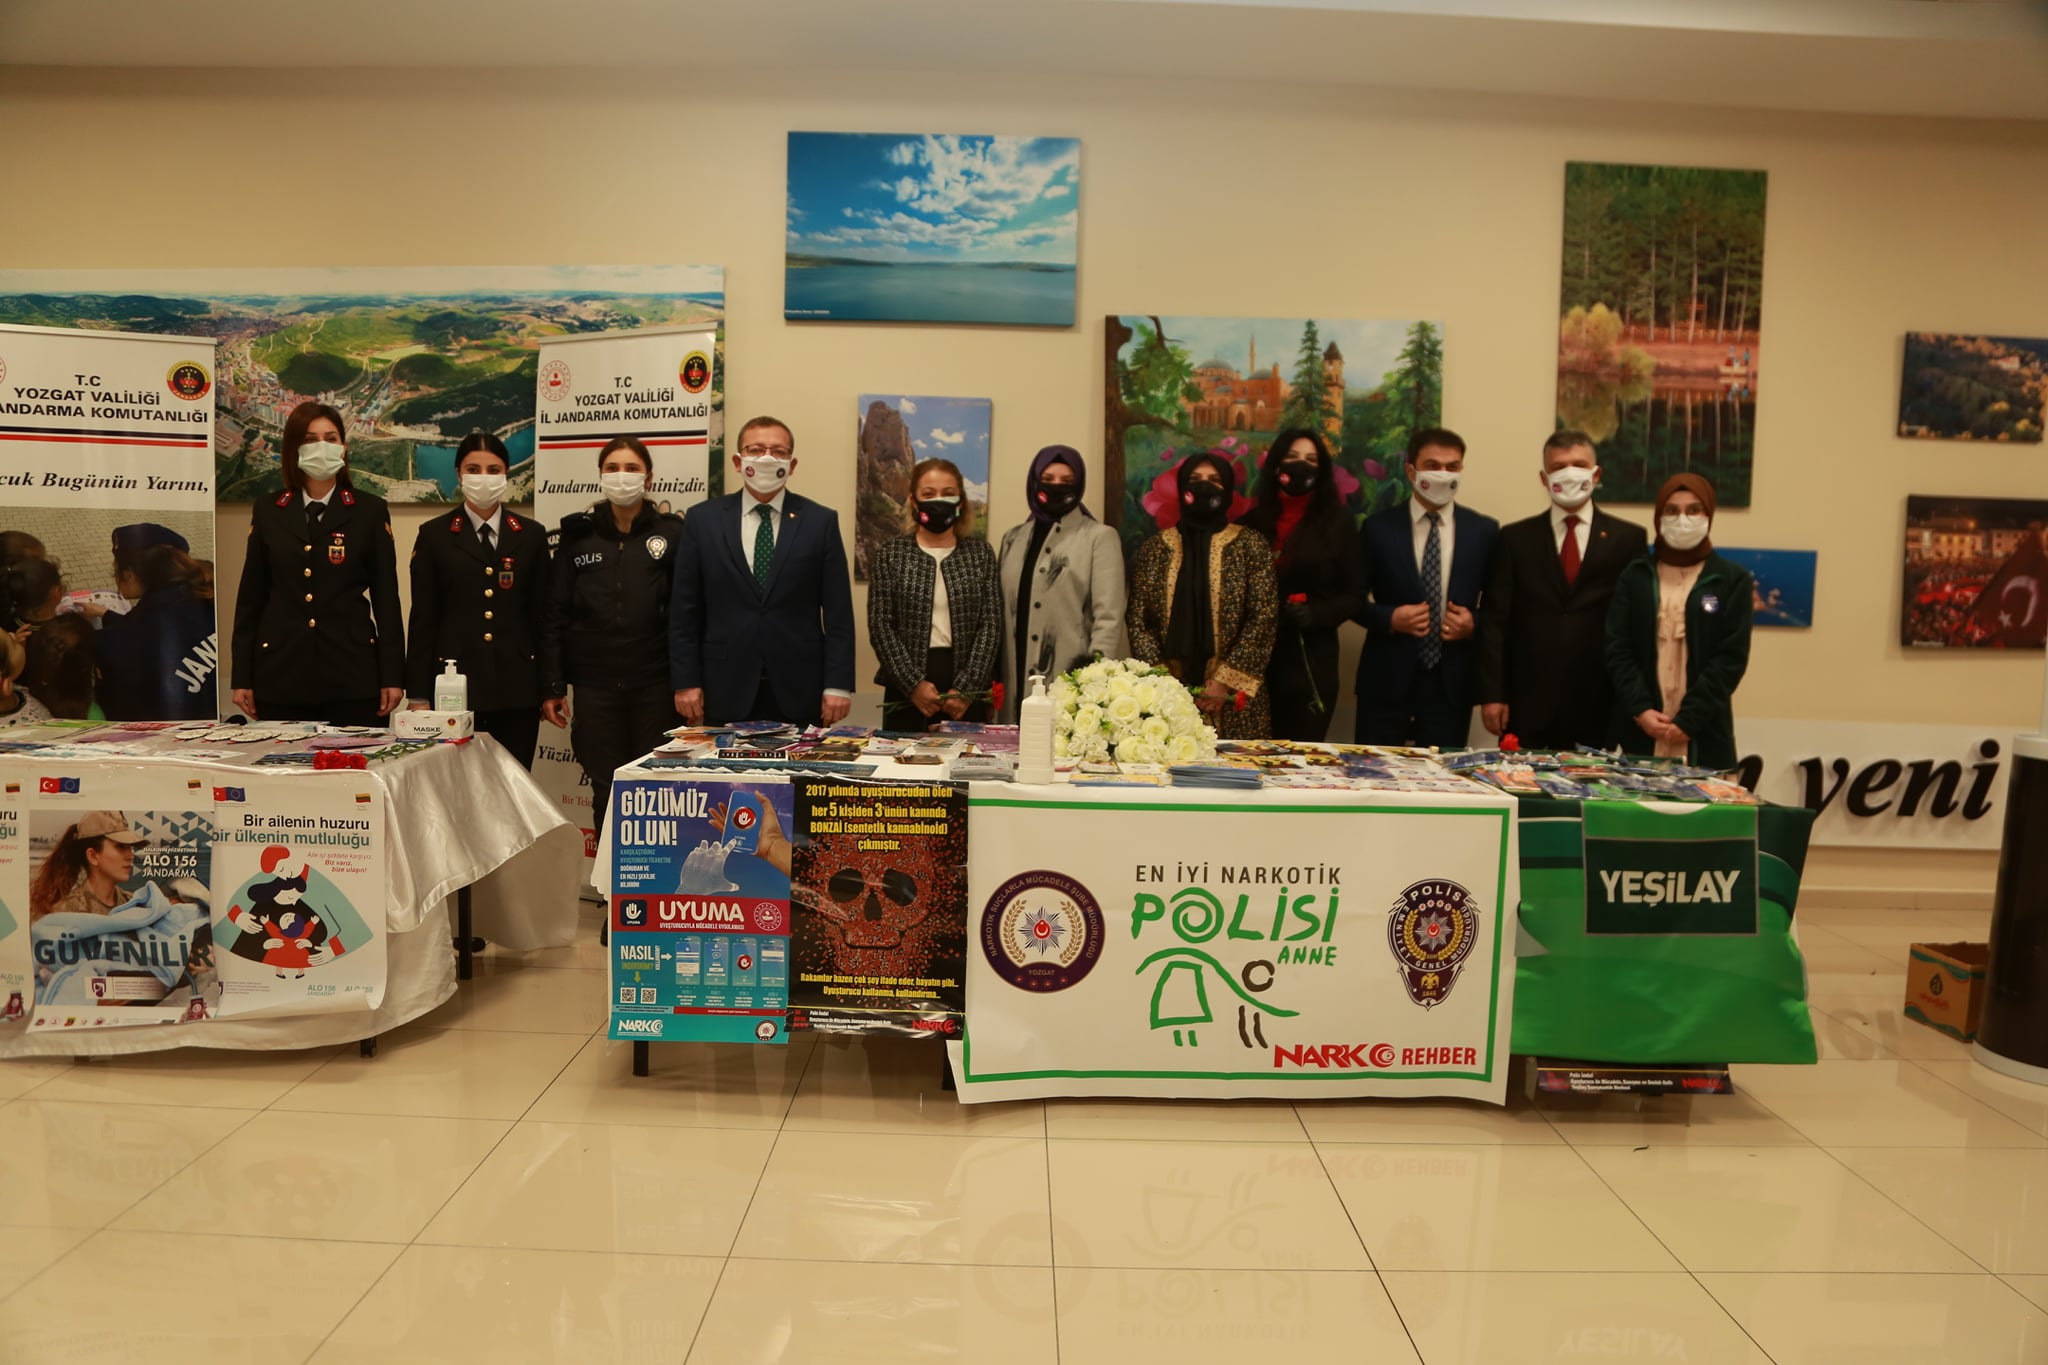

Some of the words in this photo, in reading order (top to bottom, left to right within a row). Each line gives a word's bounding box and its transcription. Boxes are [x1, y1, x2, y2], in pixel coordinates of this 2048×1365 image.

[75, 375, 101, 386] T.C
[614, 376, 632, 388] T.C
[14, 387, 85, 401] YOZGAT
[91, 390, 160, 406] VALİLİĞİ
[575, 393, 621, 407] YOZGAT
[624, 387, 674, 404] VALİLİĞİ
[91, 407, 208, 423] KOMUTANLIĞI
[540, 410, 551, 424] İL
[555, 408, 620, 424] JANDARMA
[624, 402, 708, 420] KOMUTANLIĞI
[42, 472, 137, 492] Bugünün
[146, 475, 209, 493] Yarını,
[562, 795, 574, 805] Bir
[806, 785, 827, 797] 2017
[828, 785, 860, 798] yılında
[861, 786, 931, 800] uyuşturucudan
[932, 786, 953, 798] ölen
[620, 787, 708, 818] GÖZÜMÜZ
[812, 805, 828, 817] her
[829, 802, 838, 817] 5
[839, 804, 873, 819] kişiden
[909, 806, 946, 818] kanında
[244, 814, 264, 827] Bir
[268, 815, 316, 828] ailenin
[320, 817, 370, 830] huzuru
[810, 820, 842, 834] BONZAİ
[844, 821, 886, 834] (sentetik
[887, 821, 948, 835] kannabinoid)
[234, 830, 290, 844] ülkenin
[294, 832, 370, 849] mutluluğu
[620, 820, 678, 846] OLUN!
[858, 839, 900, 852] çıkmıştır.
[142, 855, 170, 866] ALO
[174, 855, 198, 867] 156
[142, 868, 197, 878] JANDARMA
[1136, 865, 1164, 882] EN
[1177, 862, 1209, 884] İYİ
[1221, 862, 1342, 884] NARKOTİK
[1026, 876, 1070, 890] MÜCADELE
[1600, 870, 1740, 908] YEŞİLAY
[991, 880, 1026, 912] SUÇLARLA
[1410, 885, 1462, 902] POLİS
[659, 900, 744, 922] UYUMA
[1131, 886, 1340, 944] POLİSİ
[986, 914, 998, 957] NARKOTİK
[34, 932, 214, 967] GÜVENİLİR
[620, 945, 654, 960] NASIL
[1277, 946, 1337, 966] ANNE
[1416, 960, 1446, 969] GENEL
[307, 984, 324, 992] ALO
[1401, 1047, 1476, 1066] REHBER
